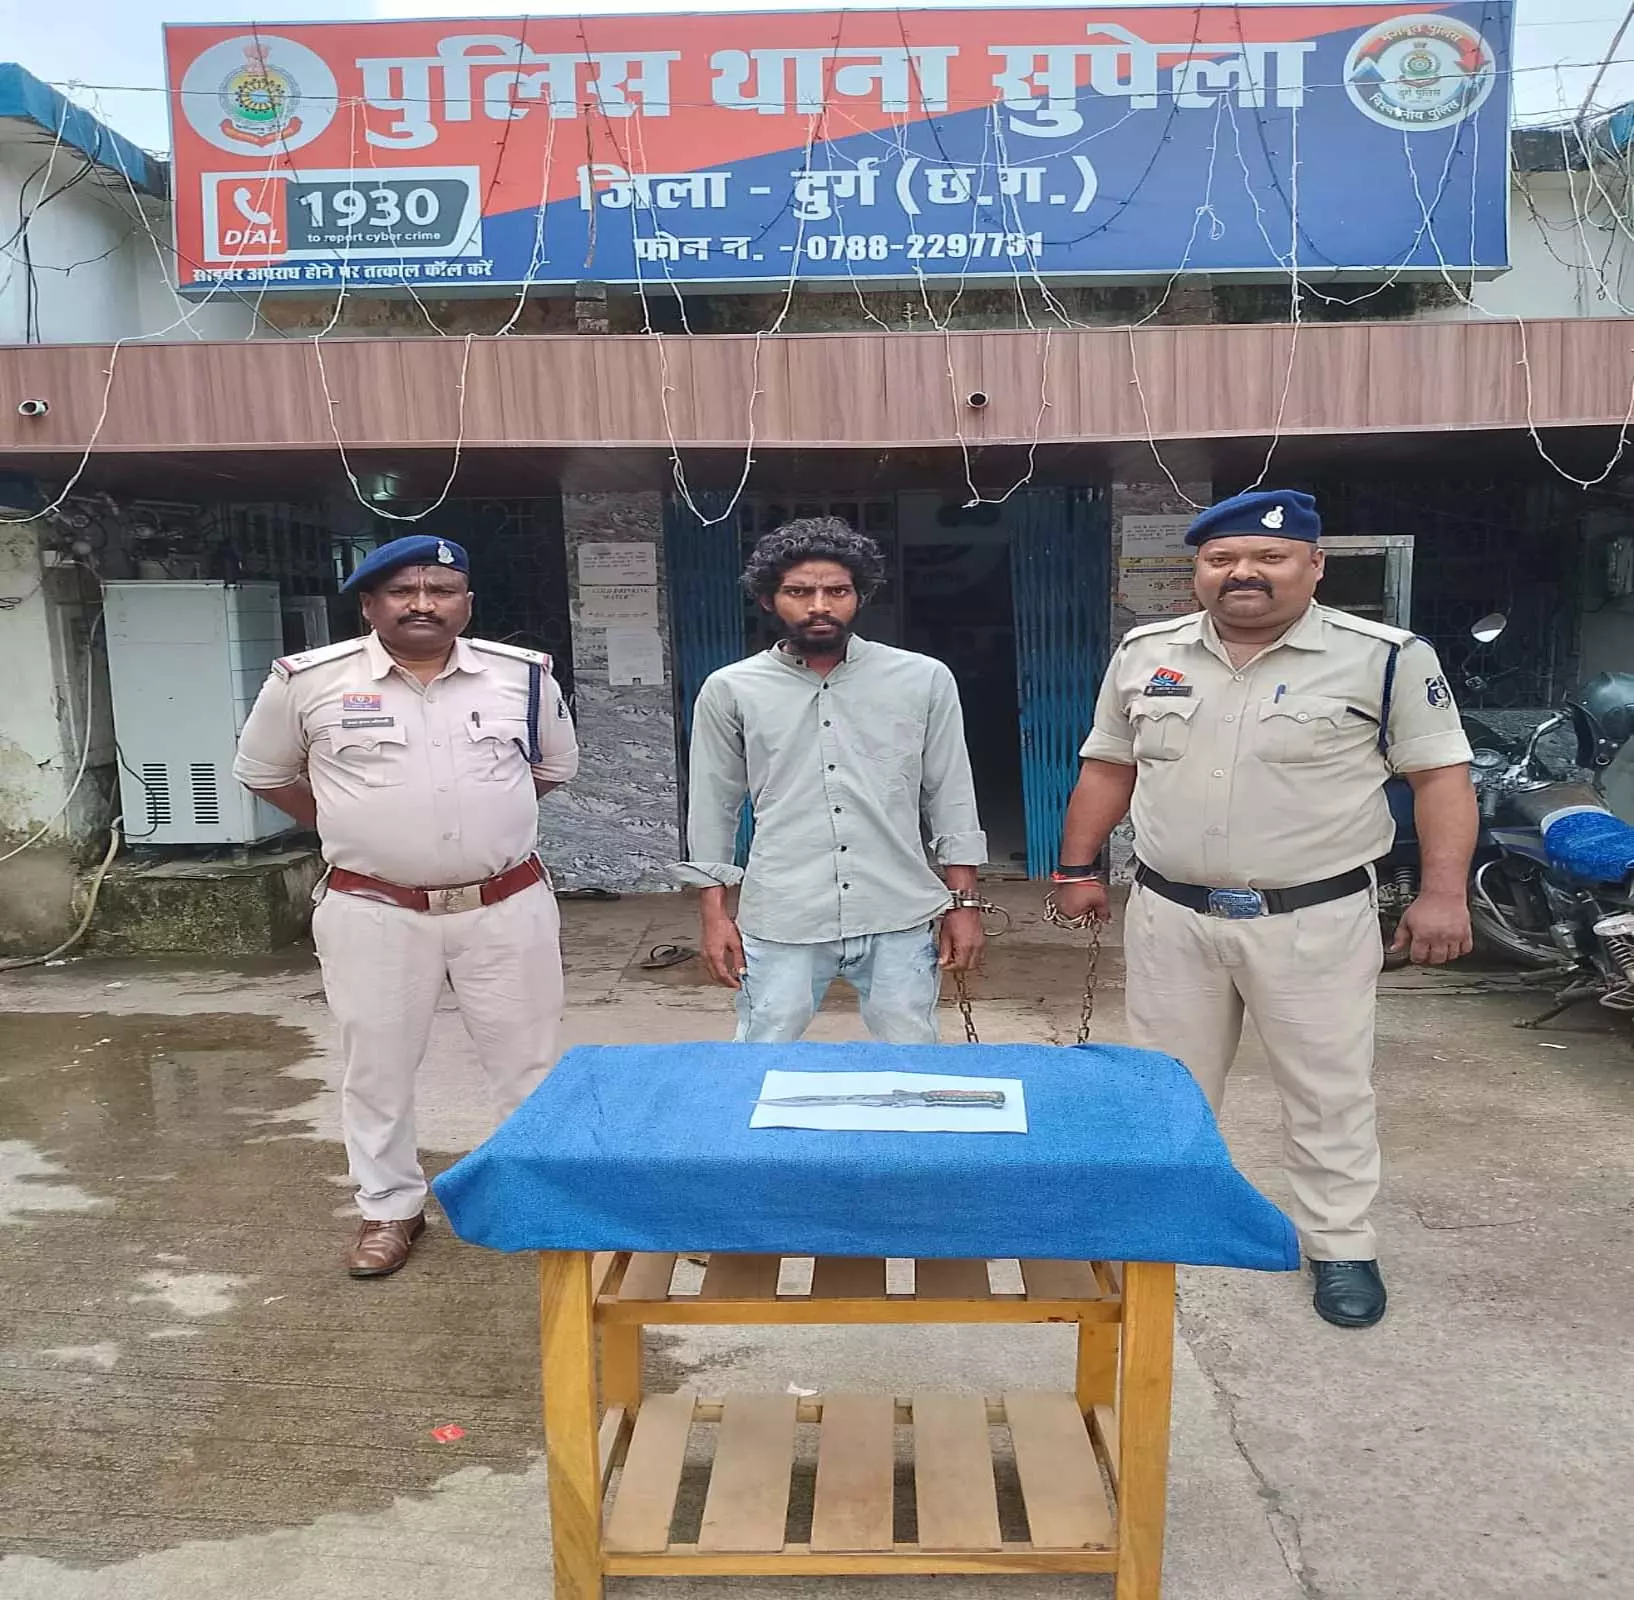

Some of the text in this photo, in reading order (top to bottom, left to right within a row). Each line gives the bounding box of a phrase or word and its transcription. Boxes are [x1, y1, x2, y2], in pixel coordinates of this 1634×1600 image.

[355, 23, 1316, 150] पुलिस थाना सुपेला
[576, 163, 732, 210] जिला
[790, 157, 880, 221] दुर्ग
[299, 188, 440, 228] 1930
[223, 229, 282, 246] DIAL
[307, 231, 441, 246] to report cyber crime
[634, 231, 712, 262] फोन
[246, 266, 301, 280] अपराध
[304, 263, 334, 280] होने
[338, 264, 360, 280] पर
[363, 263, 420, 279] तत्काल
[424, 260, 462, 278] कॉल
[464, 259, 494, 277] करें
